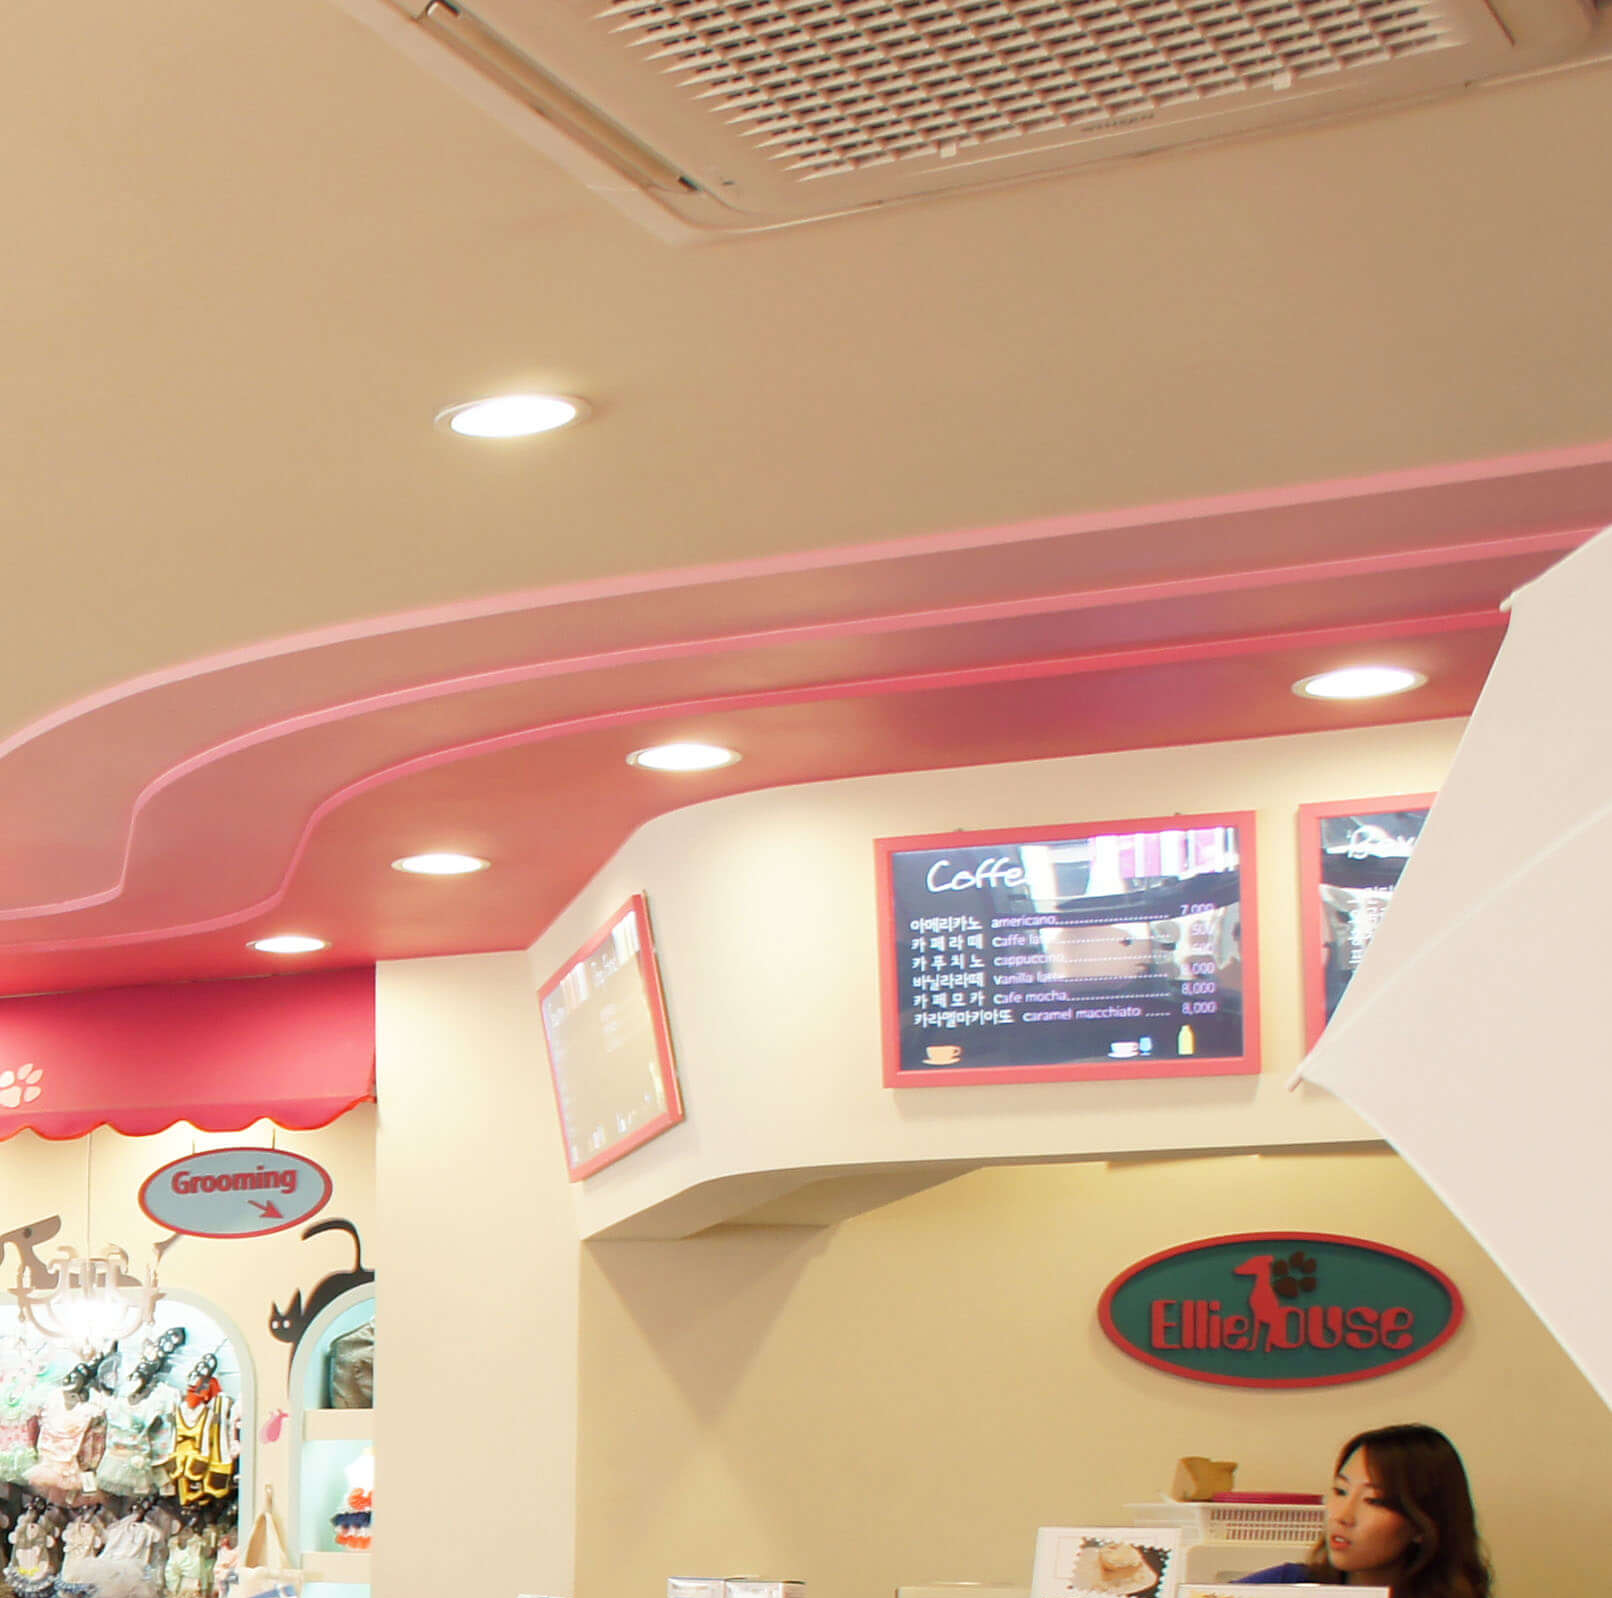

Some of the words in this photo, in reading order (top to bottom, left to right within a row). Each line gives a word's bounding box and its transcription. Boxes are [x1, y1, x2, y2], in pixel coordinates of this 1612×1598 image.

[926, 856, 1032, 893] Coffe
[910, 915, 983, 933] 아메리카노
[991, 914, 1056, 929] americano
[912, 972, 985, 991] 바닐라라떼
[1025, 989, 1067, 1003] mocha
[1022, 1007, 1072, 1023] caramel
[1075, 1004, 1142, 1020] macchiato
[171, 1165, 298, 1194] Grooming
